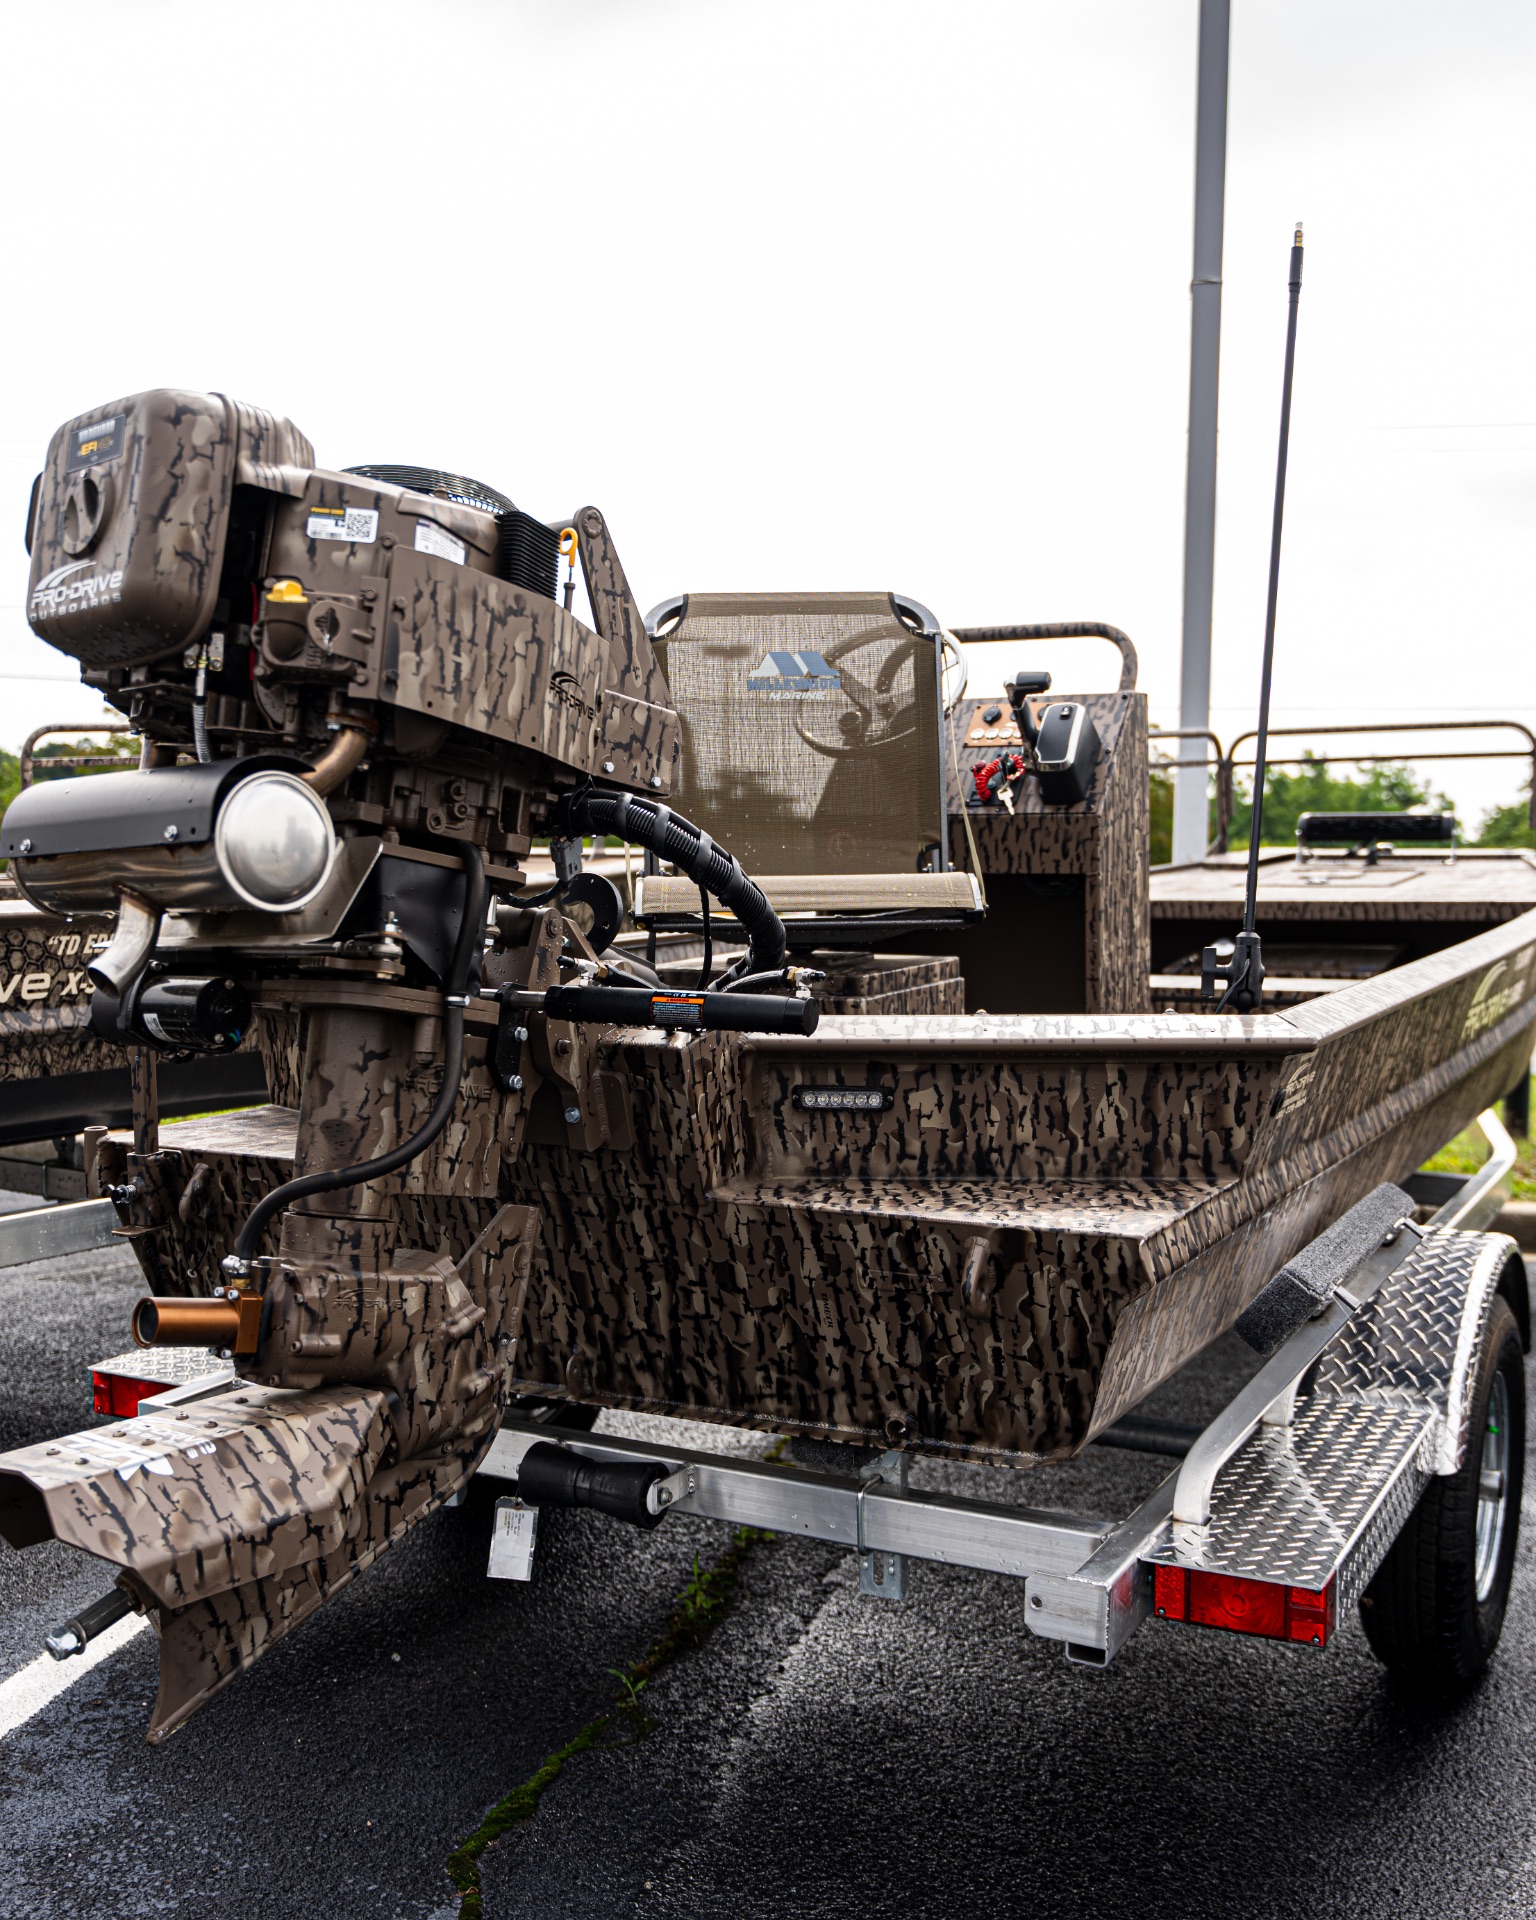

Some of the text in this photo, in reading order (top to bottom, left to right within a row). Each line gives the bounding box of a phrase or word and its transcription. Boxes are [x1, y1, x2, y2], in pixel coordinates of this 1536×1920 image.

[30, 593, 121, 622] OUTBOARDS
[747, 677, 841, 691] MILLENNIUM
[769, 691, 825, 701] MARINE
[821, 1292, 833, 1328] TIMBER
